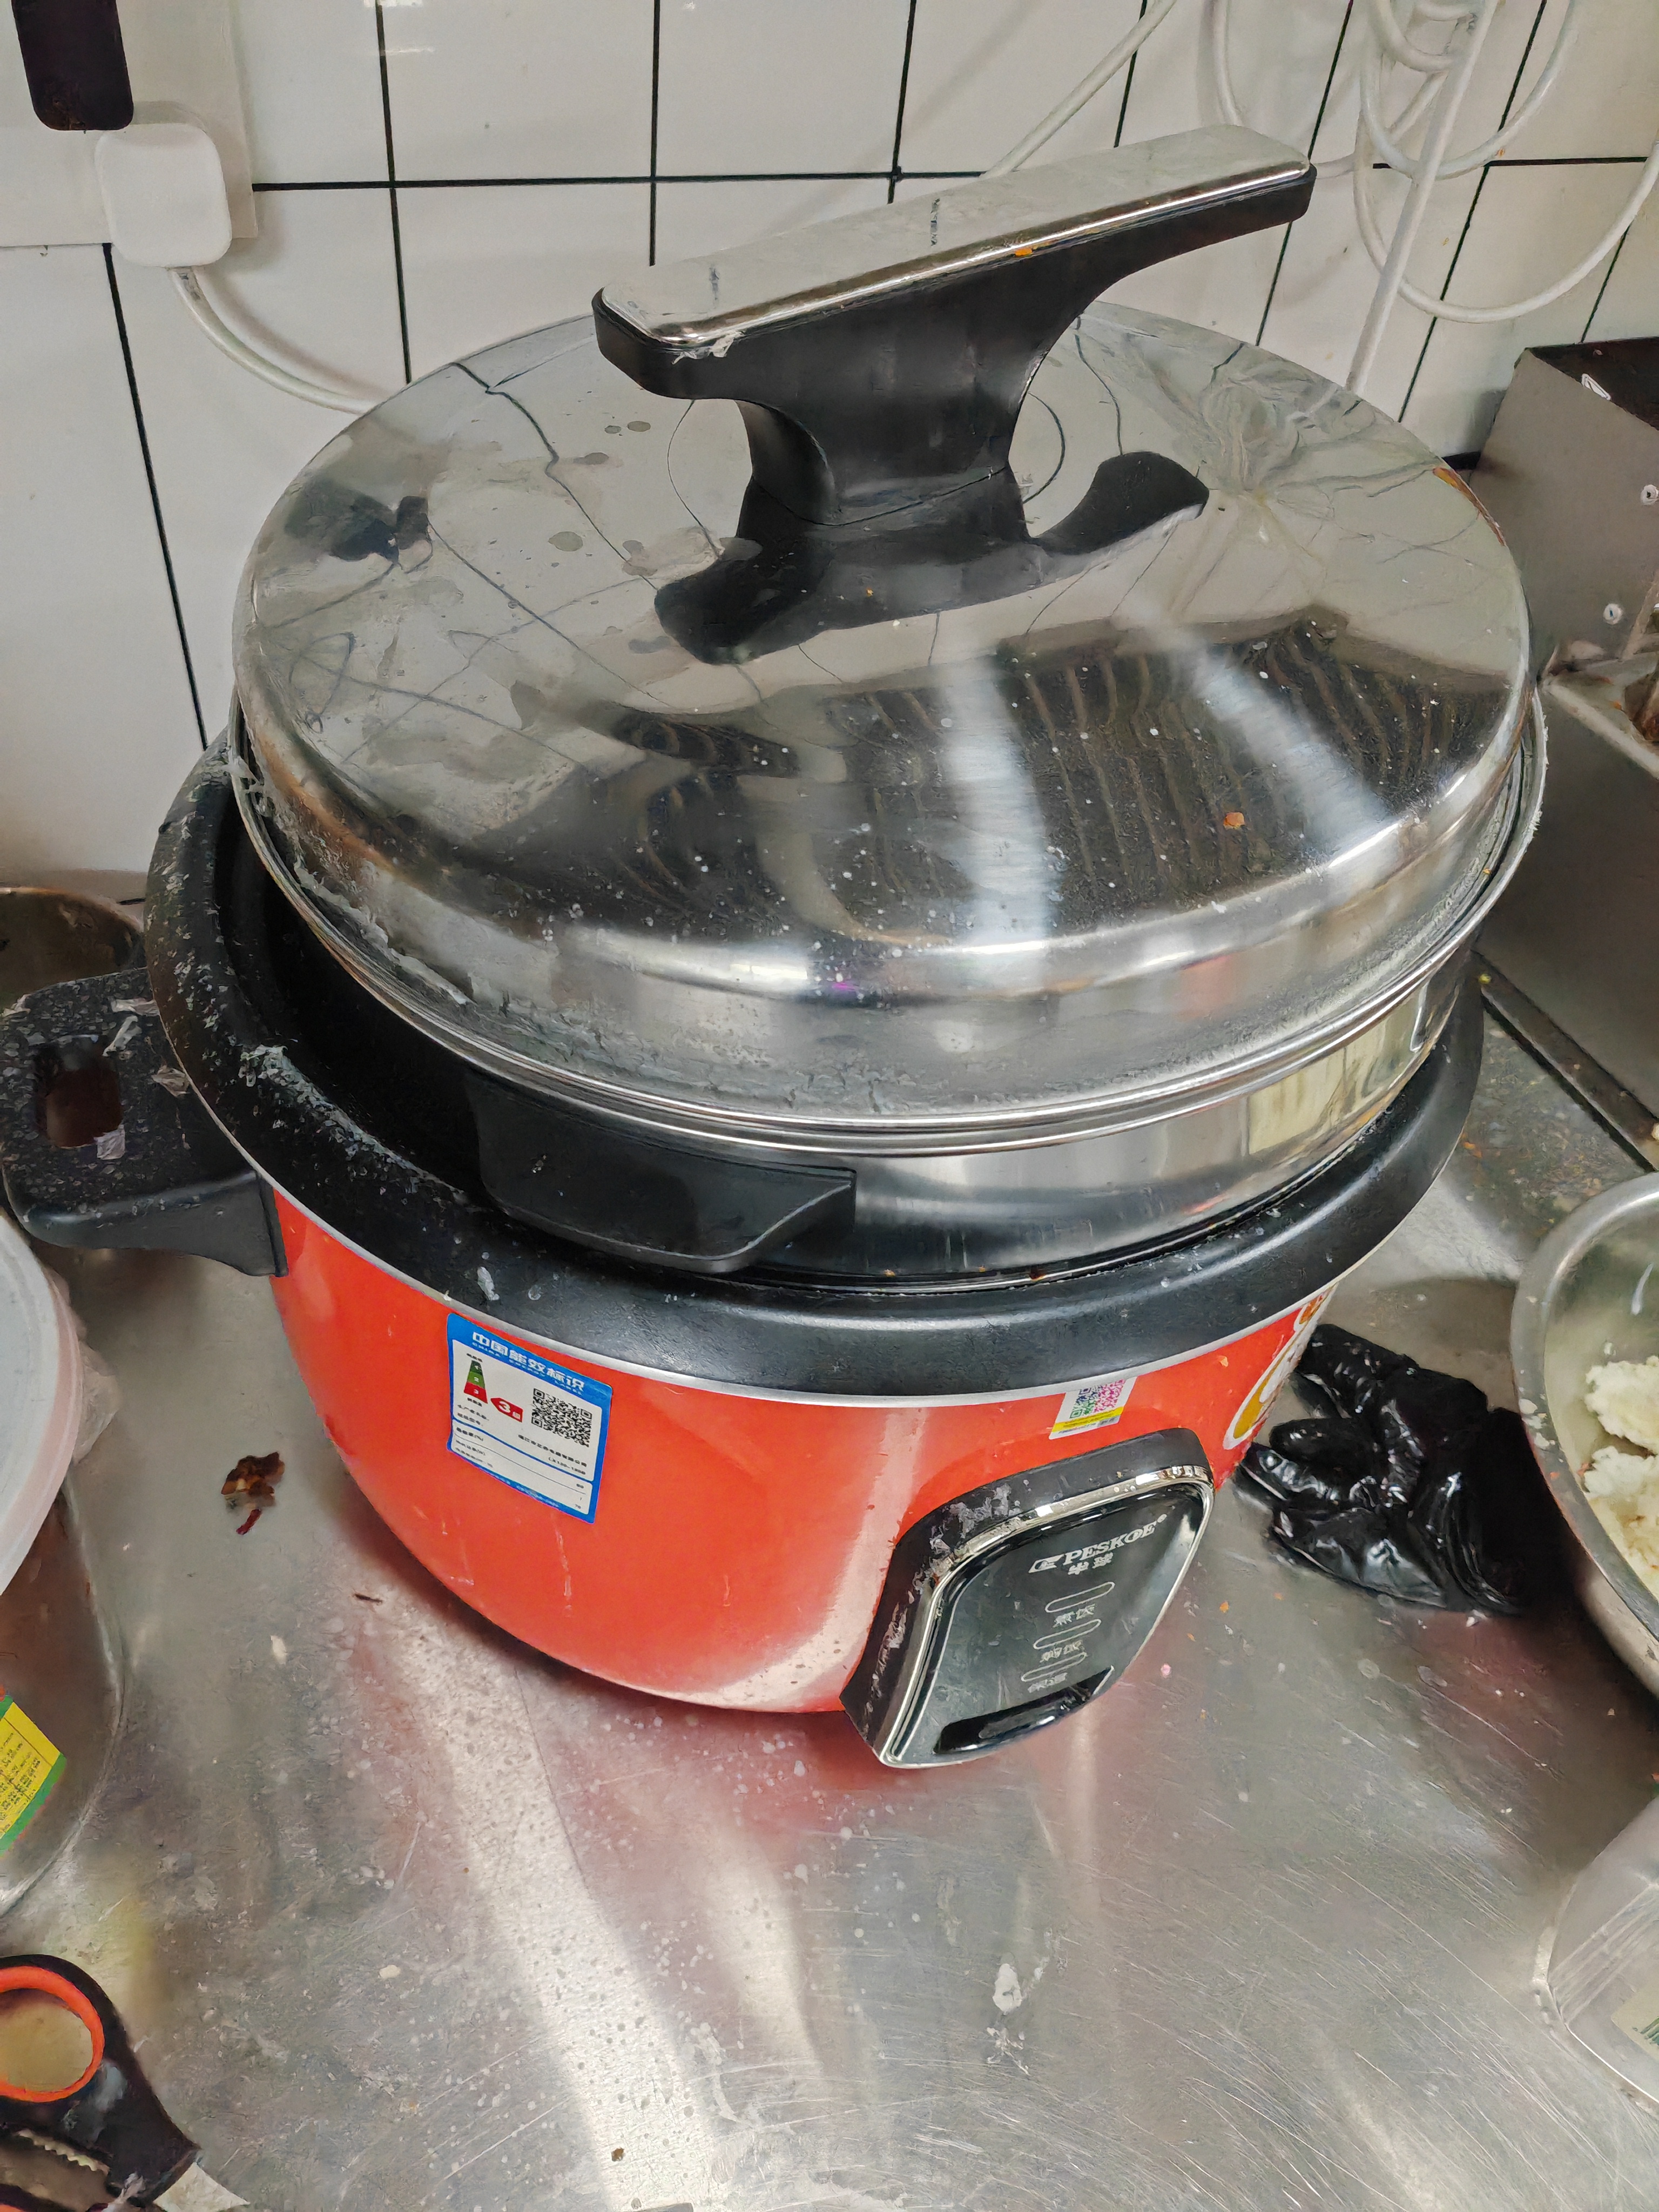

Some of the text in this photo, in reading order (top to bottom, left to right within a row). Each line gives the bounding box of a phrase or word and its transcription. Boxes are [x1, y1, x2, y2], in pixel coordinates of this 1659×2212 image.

[471, 1331, 585, 1392] 中国能效标识
[1062, 1522, 1158, 1566] PESKOE
